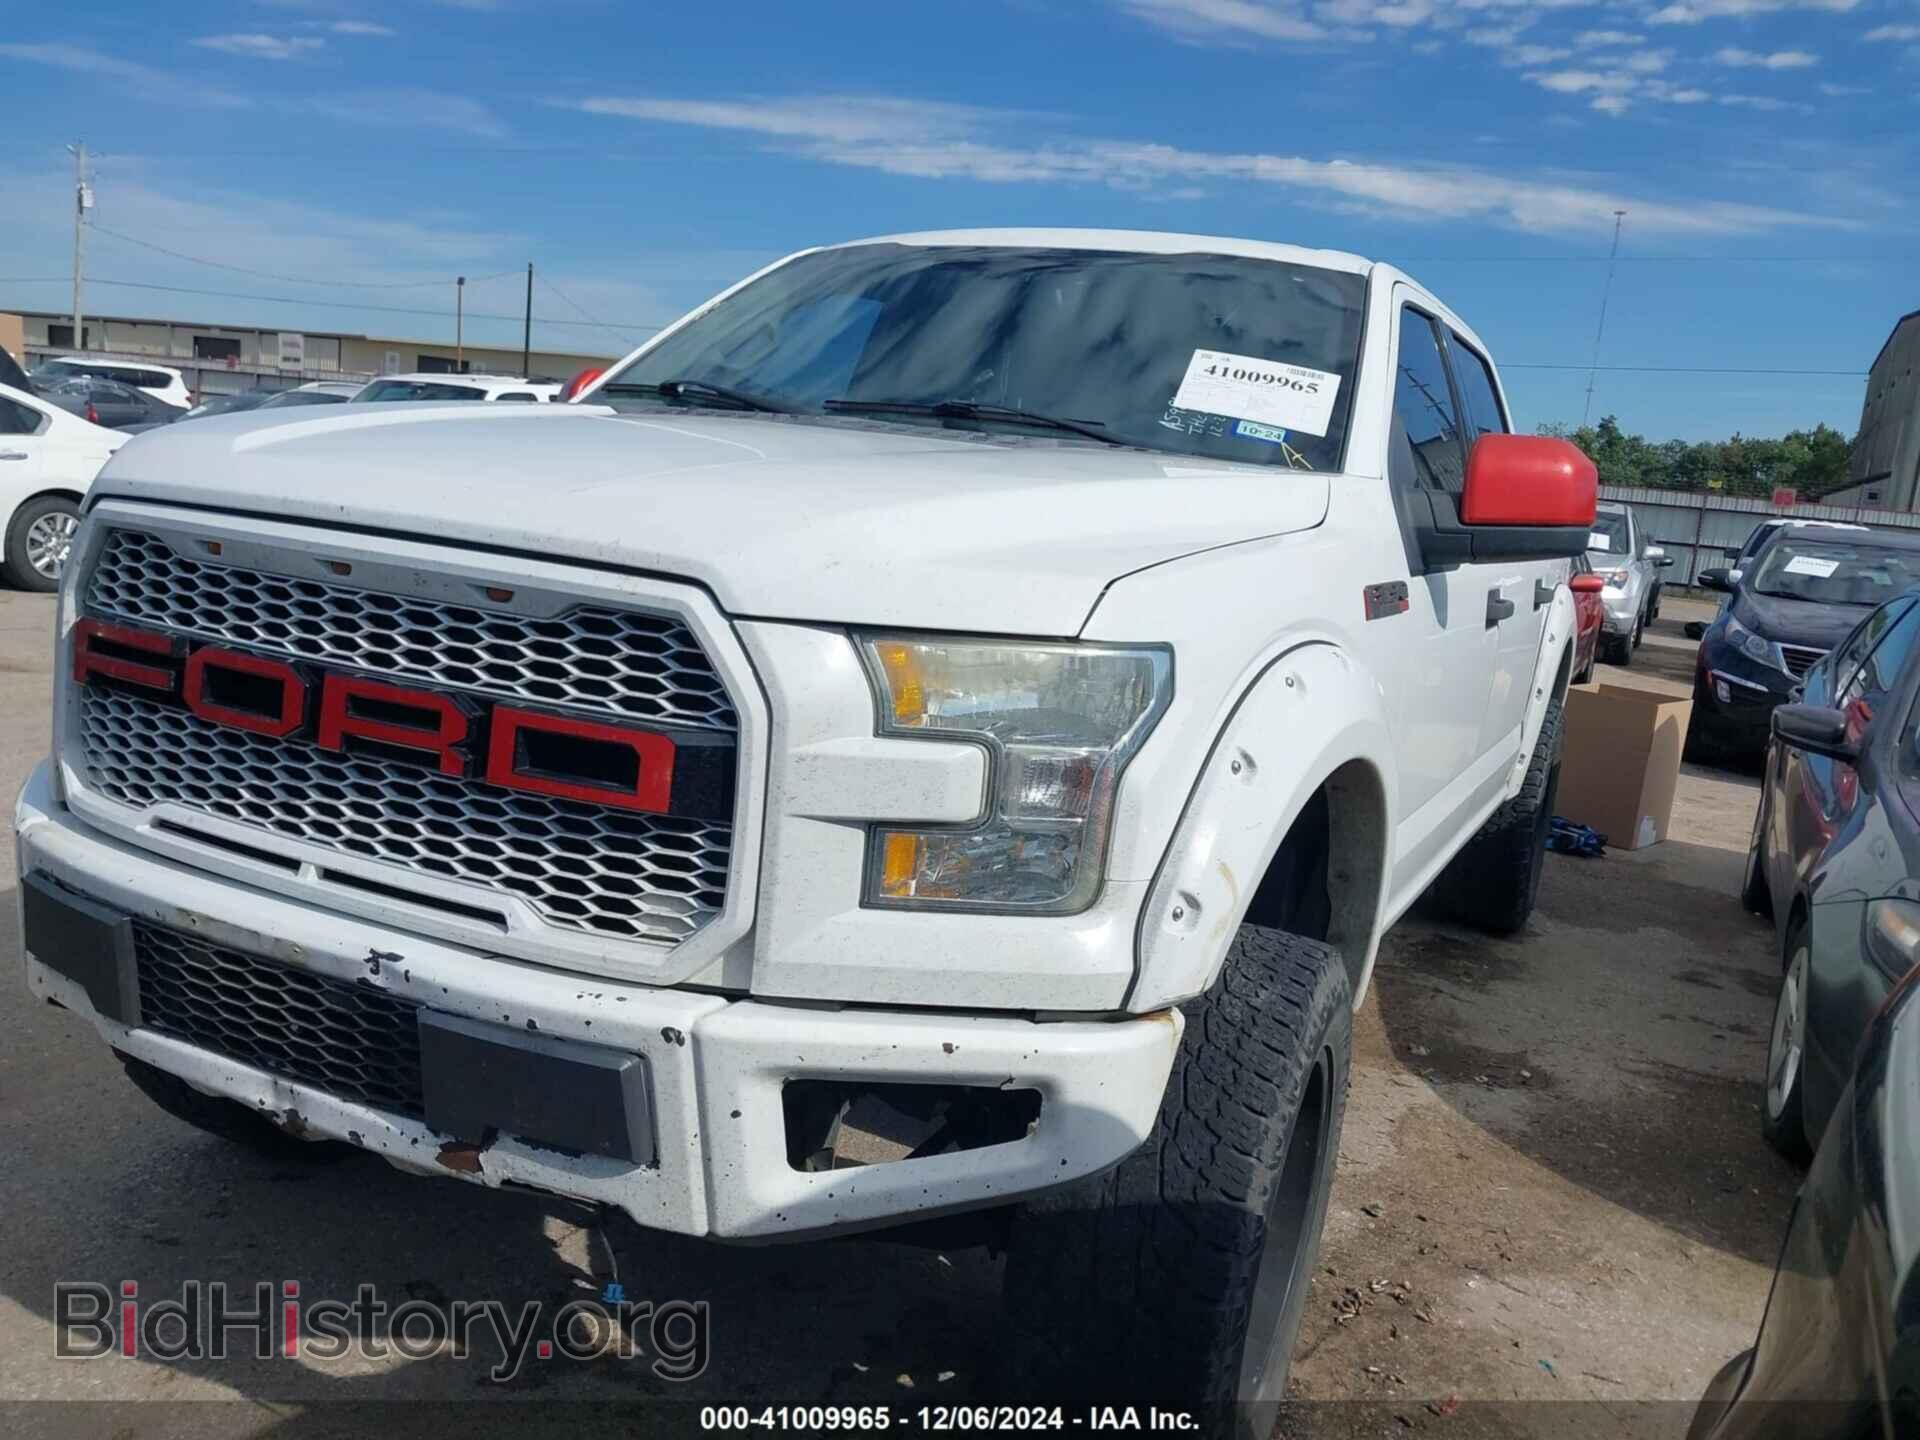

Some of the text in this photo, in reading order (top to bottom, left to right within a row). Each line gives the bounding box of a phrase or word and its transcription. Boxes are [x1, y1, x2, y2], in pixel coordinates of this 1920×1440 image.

[1203, 364, 1320, 394] 41009965
[1240, 424, 1283, 440] 10-24
[72, 616, 676, 814] FORD
